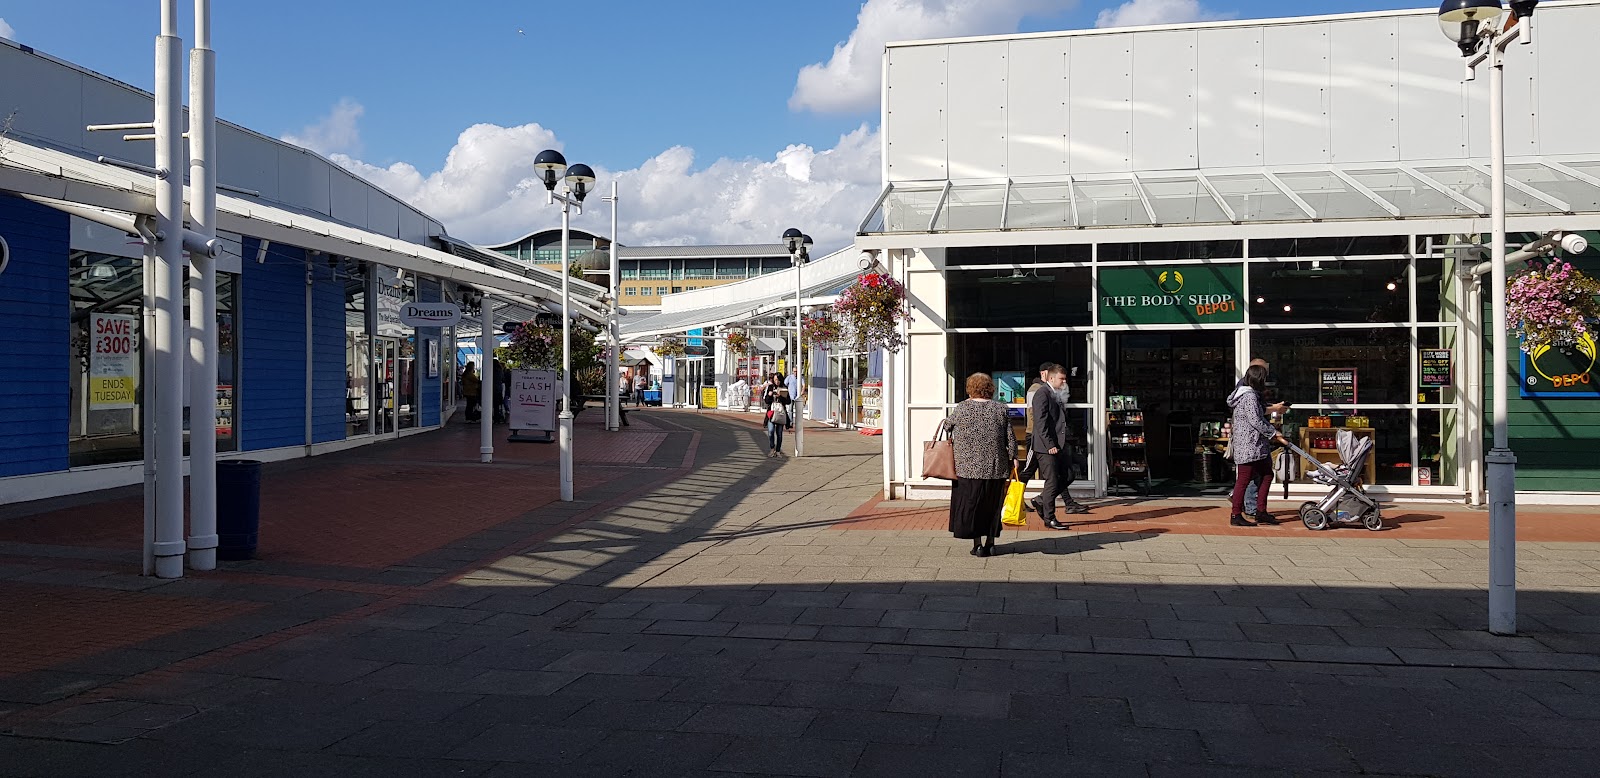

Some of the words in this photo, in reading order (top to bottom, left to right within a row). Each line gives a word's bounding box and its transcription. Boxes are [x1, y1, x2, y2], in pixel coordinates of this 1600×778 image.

[1103, 296, 1137, 307] THE
[1141, 295, 1184, 306] BODY
[1188, 294, 1232, 305] SHOP
[407, 306, 454, 317] Dreams
[1196, 300, 1236, 316] DEPOT
[96, 318, 130, 335] SAVE
[96, 336, 130, 354] £300
[1335, 338, 1354, 346] SKIN
[102, 380, 125, 389] ENDS
[515, 382, 551, 390] FLASH
[1552, 373, 1590, 388] DEPO
[95, 391, 131, 401] TUESDAY
[519, 394, 550, 403] SALE.
